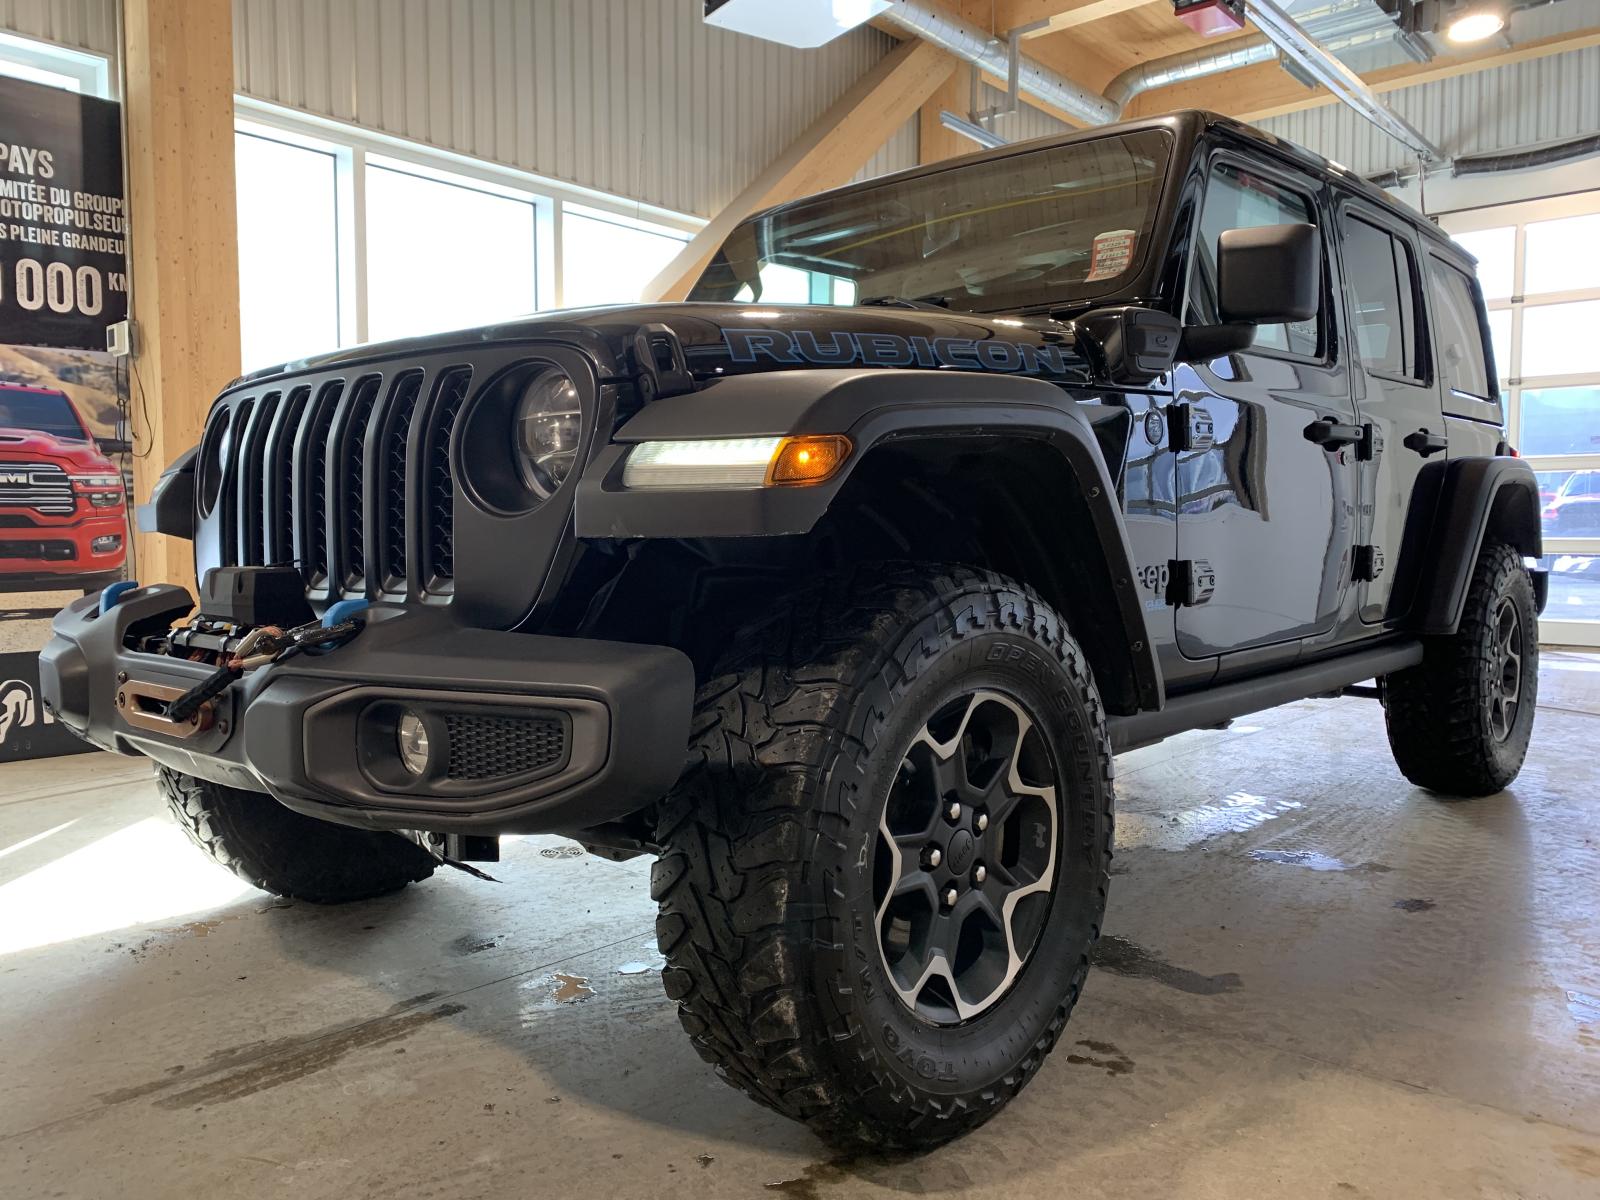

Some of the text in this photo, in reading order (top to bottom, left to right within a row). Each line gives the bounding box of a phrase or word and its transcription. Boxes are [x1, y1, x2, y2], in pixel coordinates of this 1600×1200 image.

[0, 142, 54, 179] PAYS
[50, 187, 70, 207] DU
[74, 191, 126, 217] GROUP
[10, 224, 60, 247] PLEINE
[62, 231, 127, 255] GRANDEU
[15, 258, 103, 316] 000
[721, 328, 1066, 373] RUBICON
[985, 640, 1057, 686] OPEN
[881, 1022, 960, 1083] TOYO
